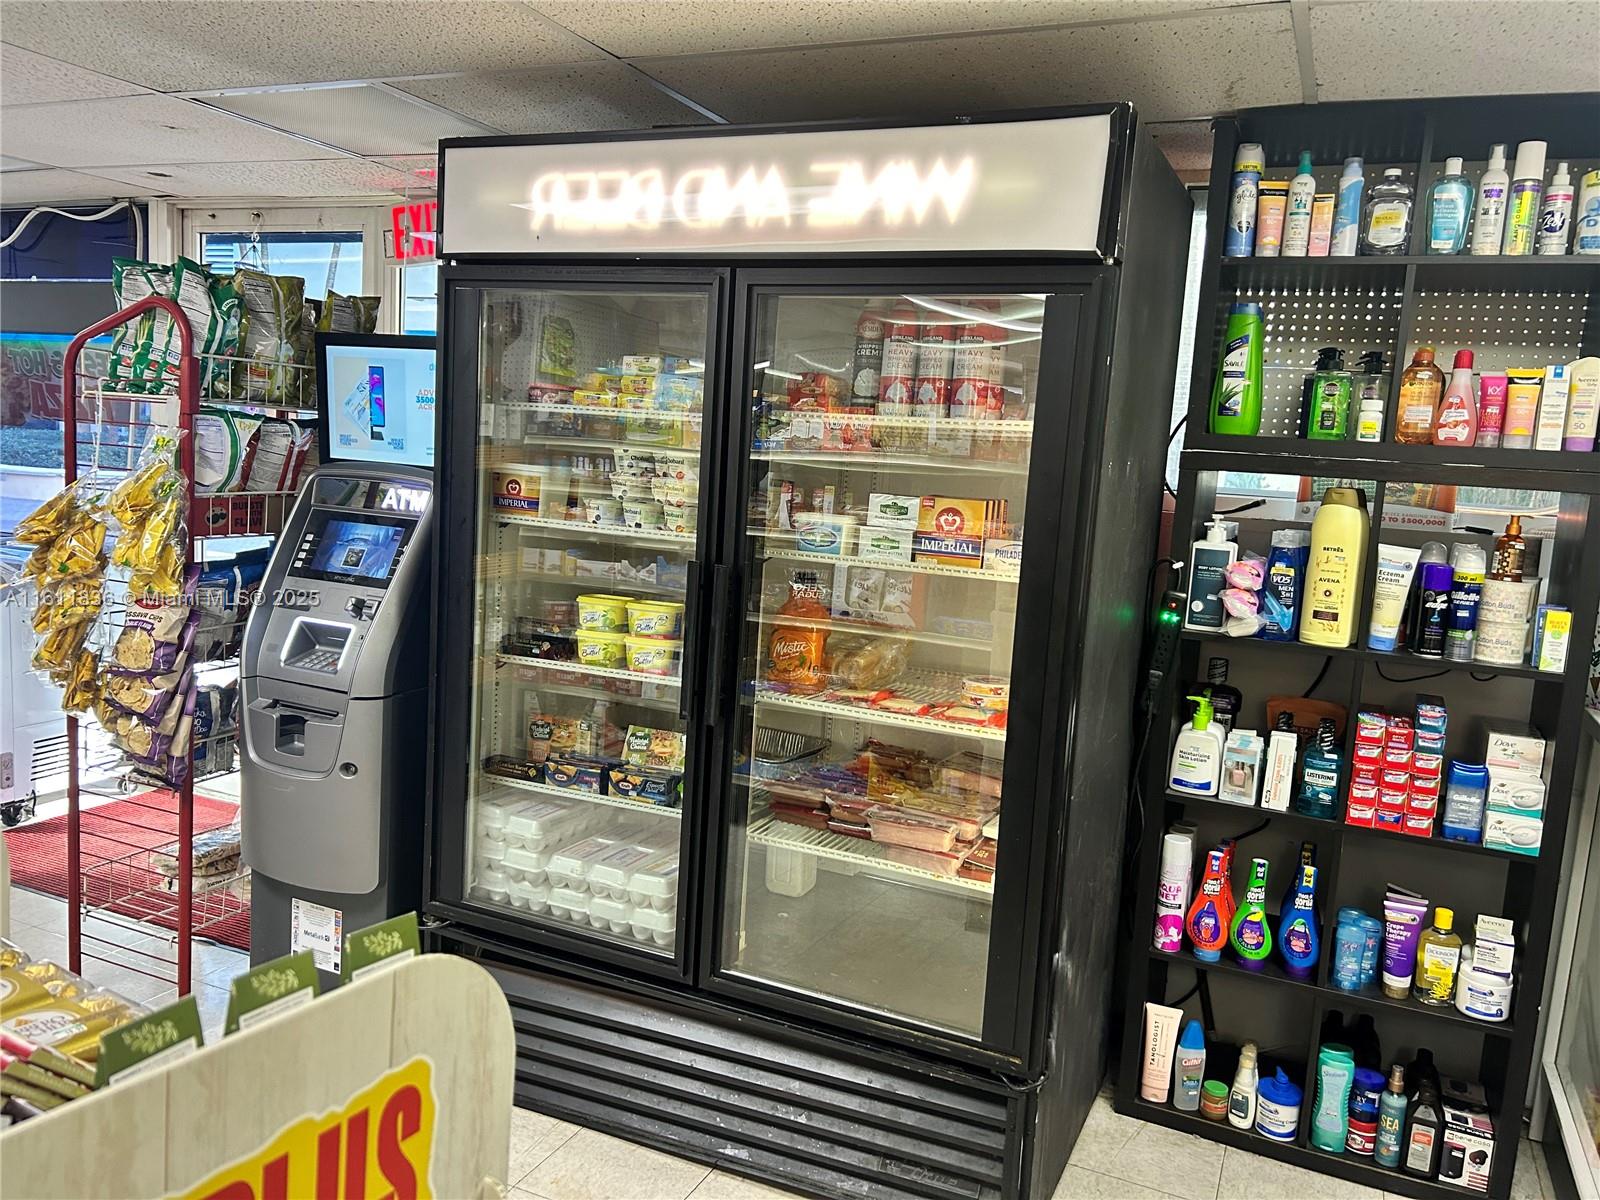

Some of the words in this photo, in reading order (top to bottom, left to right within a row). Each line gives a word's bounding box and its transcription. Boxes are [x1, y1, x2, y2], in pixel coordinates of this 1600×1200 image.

[392, 202, 437, 260] EXI
[415, 395, 434, 404] 3500
[1573, 422, 1586, 430] 50
[381, 487, 430, 513] ATM
[498, 499, 529, 509] IMPERIAL
[1401, 516, 1446, 527] $500,000!
[921, 538, 975, 554] IMPERIAL
[1378, 569, 1405, 579] Eczema
[1377, 575, 1400, 584] Cream
[1496, 601, 1515, 610] Buds
[635, 621, 658, 633] Butter!
[1494, 637, 1513, 646] Buds
[774, 640, 811, 656] Mistic
[1493, 738, 1517, 748] Dove
[1179, 749, 1211, 760] Moisturizing
[1306, 771, 1336, 781] LISTERINE
[1492, 786, 1511, 795] Dove
[1488, 823, 1507, 832] Dove
[1386, 922, 1405, 930] Crepe
[1481, 918, 1506, 928] Aveeno
[1385, 933, 1406, 941] Lotion
[1386, 927, 1412, 938] Therapy
[1149, 1020, 1161, 1066] TANOLOGIST
[1380, 1114, 1400, 1130] SEA
[1454, 1134, 1473, 1143] bene
[1473, 1139, 1491, 1148] casa
